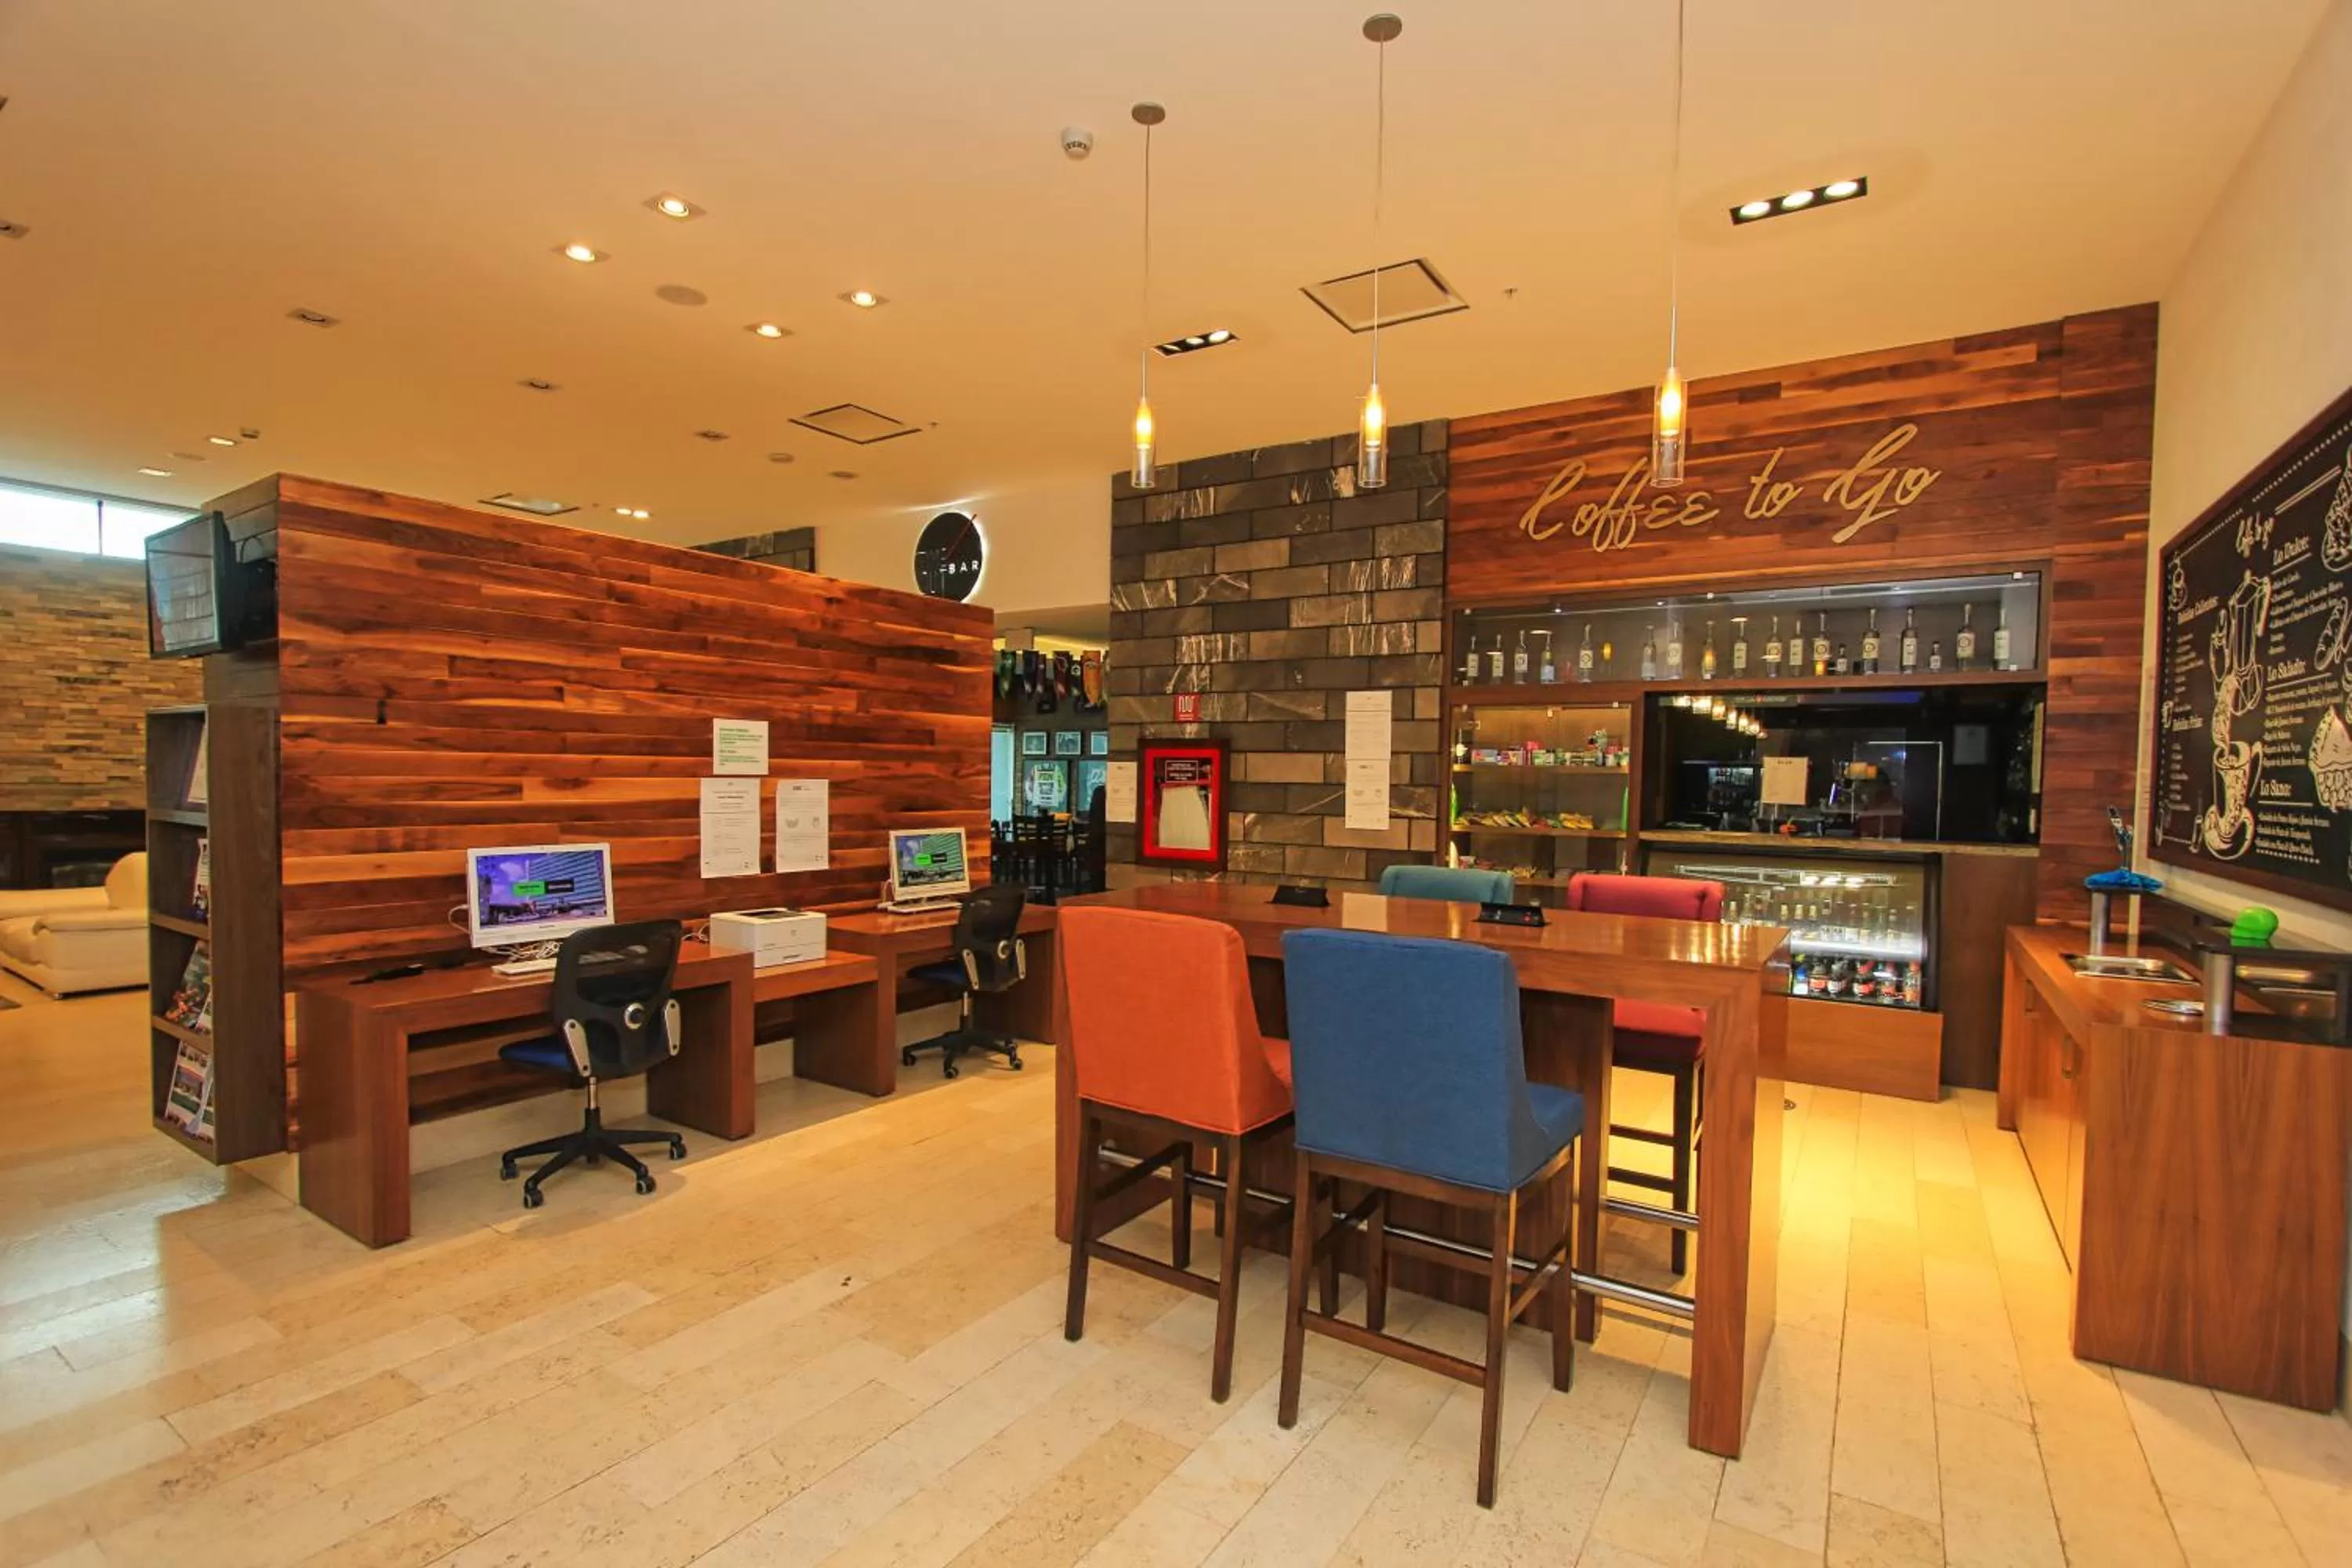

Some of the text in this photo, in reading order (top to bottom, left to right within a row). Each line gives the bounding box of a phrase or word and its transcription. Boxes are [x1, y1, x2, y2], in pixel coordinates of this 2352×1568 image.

[1519, 423, 1942, 552] Coffee to Go
[948, 559, 979, 575] BAR
